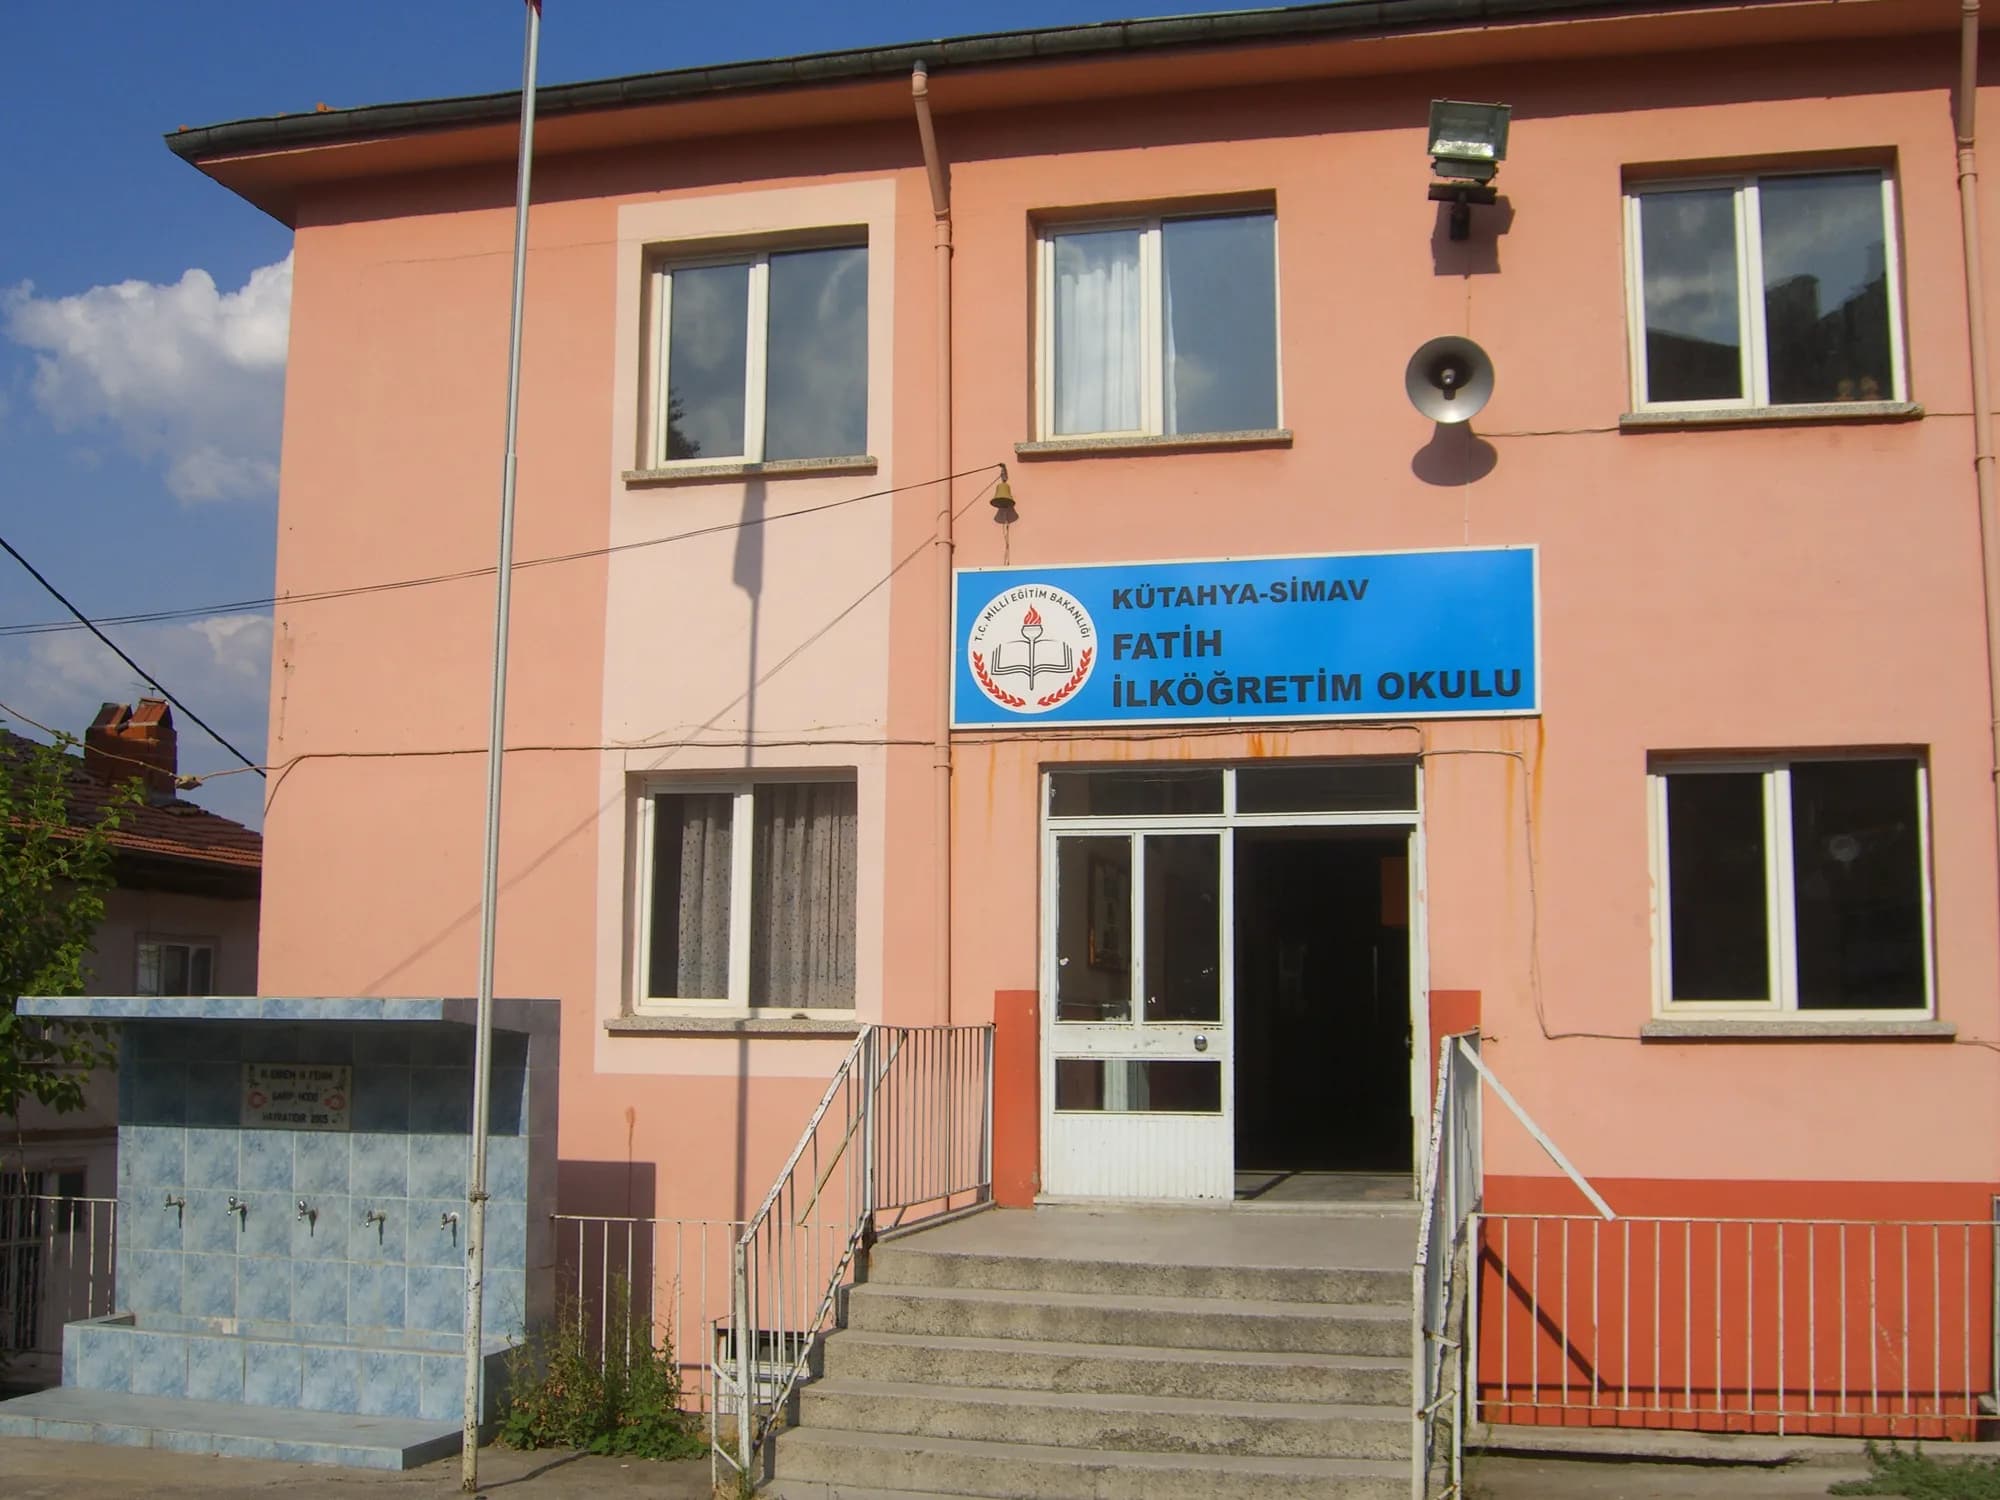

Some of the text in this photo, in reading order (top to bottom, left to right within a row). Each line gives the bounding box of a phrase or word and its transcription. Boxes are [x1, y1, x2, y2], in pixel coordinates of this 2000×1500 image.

[1112, 577, 1368, 610] KÜTAHYA-SİMAV
[983, 594, 1010, 622] MİLLİ
[1010, 587, 1048, 602] EĞİTİM
[1049, 592, 1091, 639] BAKANLIĞI
[1112, 624, 1223, 660] FATİH
[1112, 668, 1522, 708] İLKÖĞRETİM OKULU
